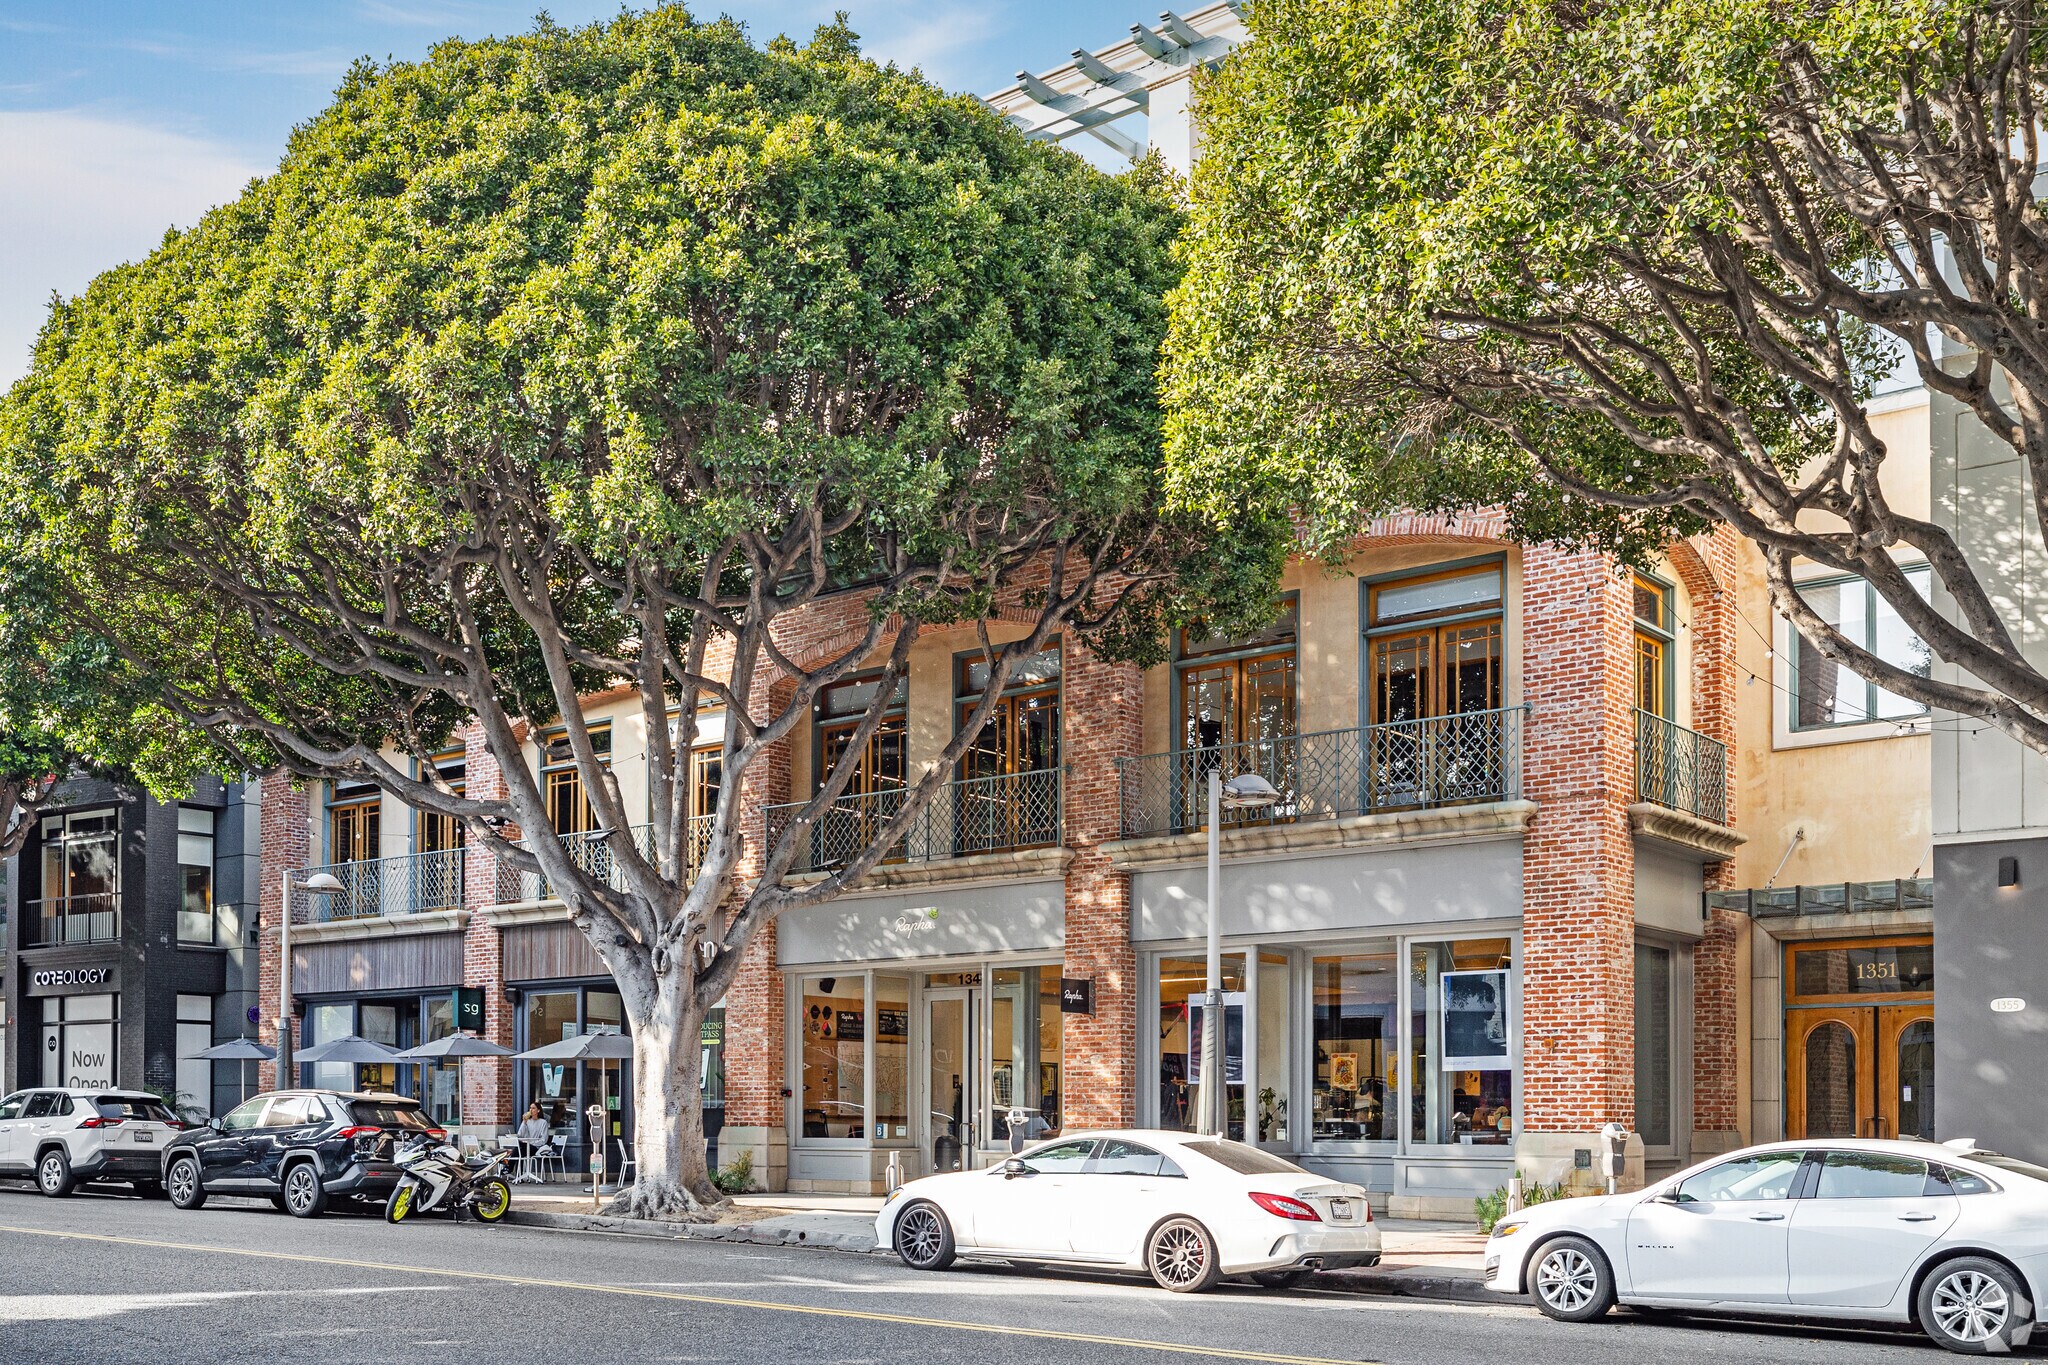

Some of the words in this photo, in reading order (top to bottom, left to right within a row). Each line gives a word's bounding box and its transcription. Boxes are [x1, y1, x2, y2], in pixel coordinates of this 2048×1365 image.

[895, 914, 936, 939] Rapha
[34, 968, 107, 986] COREOLOGY
[1856, 961, 1898, 980] 1351
[1064, 989, 1084, 1004] Rapha
[463, 1003, 479, 1015] sg
[1995, 1000, 2019, 1010] 1355
[72, 1050, 106, 1068] Now
[877, 1126, 882, 1136] B
